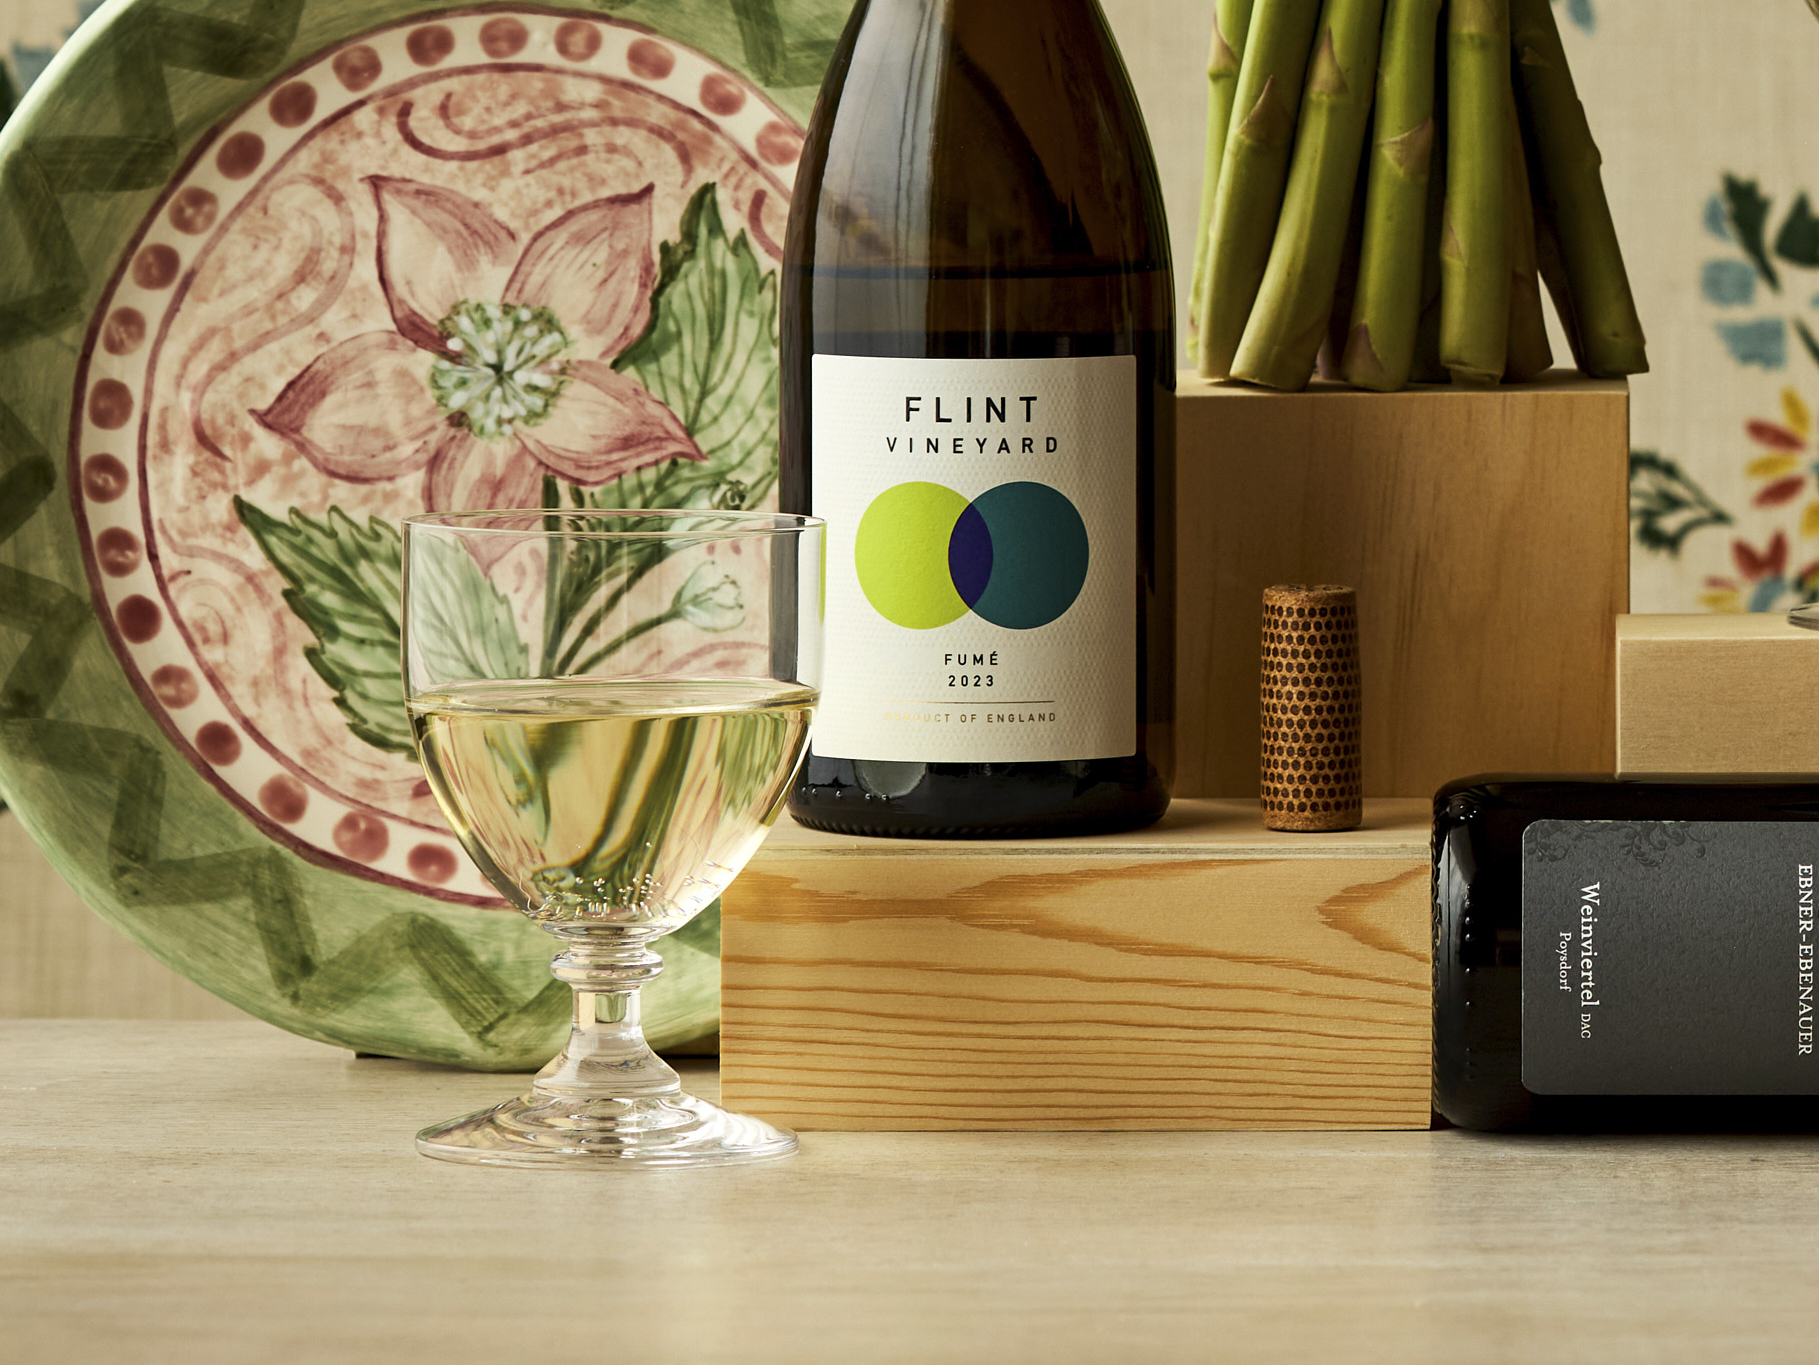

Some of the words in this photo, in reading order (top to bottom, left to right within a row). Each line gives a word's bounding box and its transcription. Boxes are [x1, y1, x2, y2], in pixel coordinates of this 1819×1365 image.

[905, 396, 1038, 423] FLINT
[886, 437, 1058, 454] VINEYARD
[944, 650, 1000, 666] FUMÉ
[947, 674, 995, 688] 2023
[960, 713, 977, 723] OF
[987, 712, 1056, 723] ENGLAND
[1580, 881, 1601, 1008] Weinviertel
[1555, 931, 1572, 992] Poysdorf
[1798, 863, 1814, 1056] EBNER-EBENAUER
[1580, 1013, 1592, 1039] DAC
